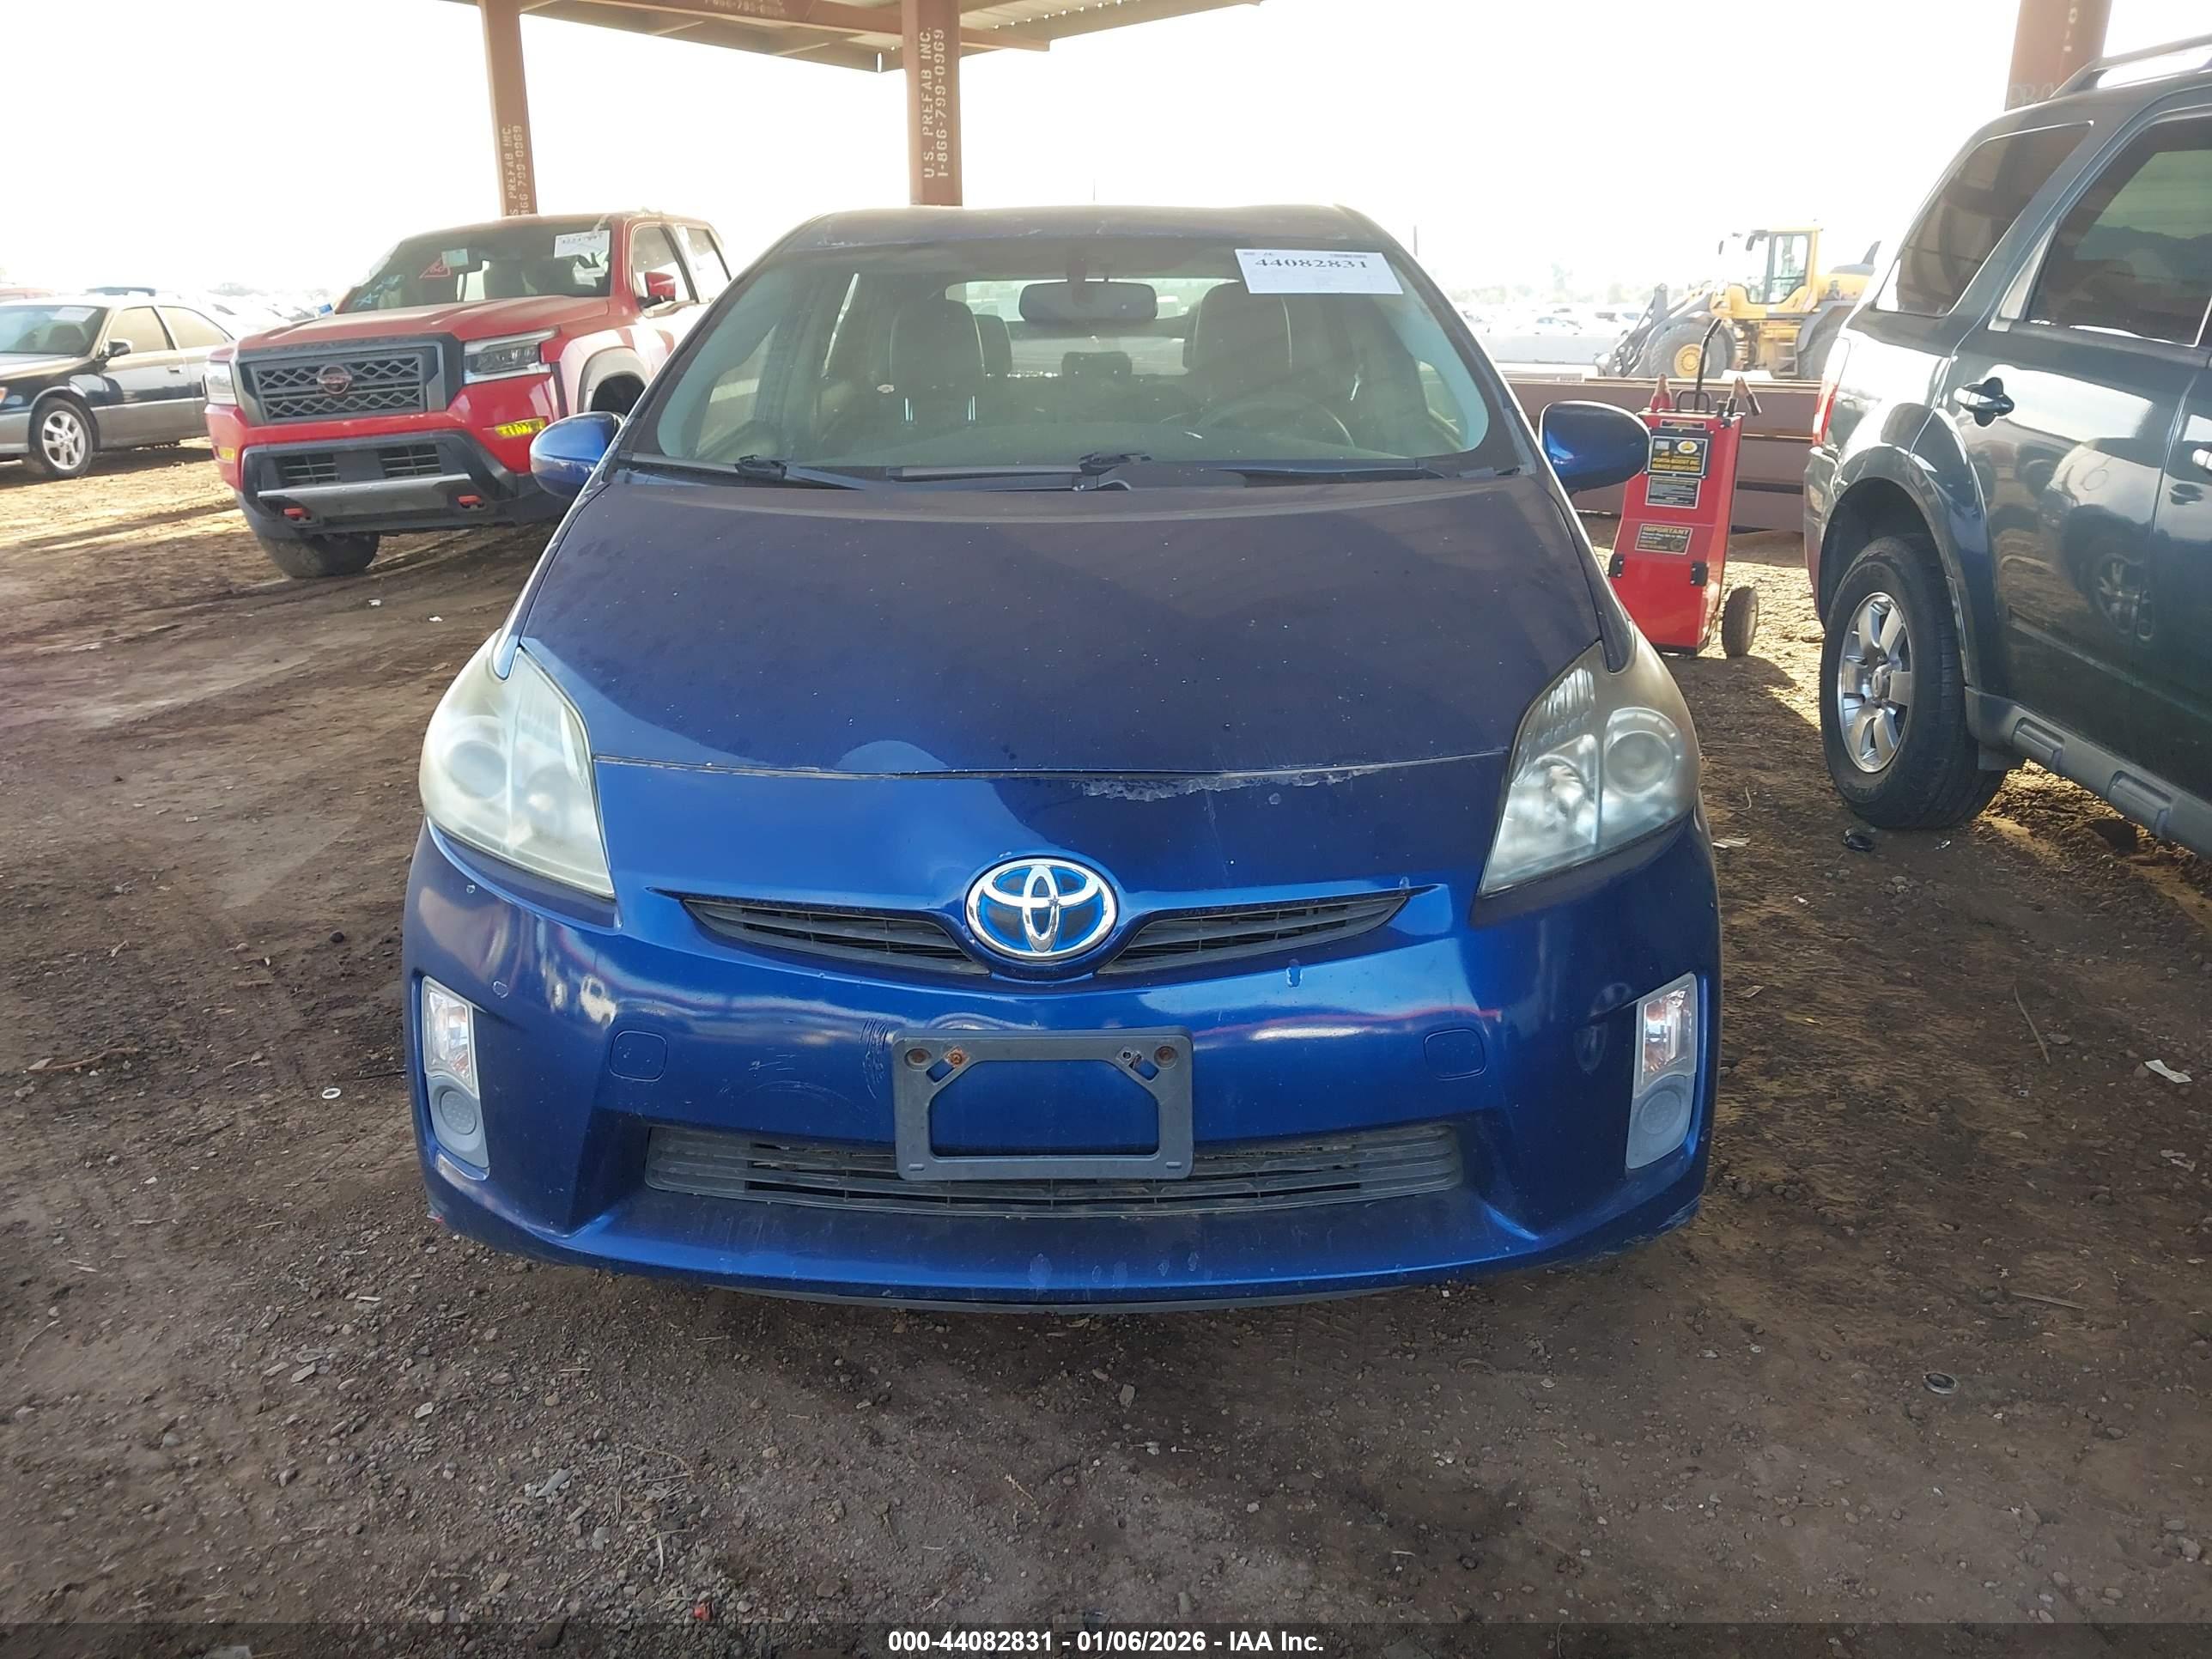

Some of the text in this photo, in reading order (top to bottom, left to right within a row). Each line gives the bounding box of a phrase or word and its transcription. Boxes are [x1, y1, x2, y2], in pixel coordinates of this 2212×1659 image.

[920, 27, 935, 179] U.S. PREFAB INC.
[933, 28, 949, 177] 1-866-799-0969
[504, 153, 517, 199] PREFAB
[1255, 258, 1368, 269] 44082831
